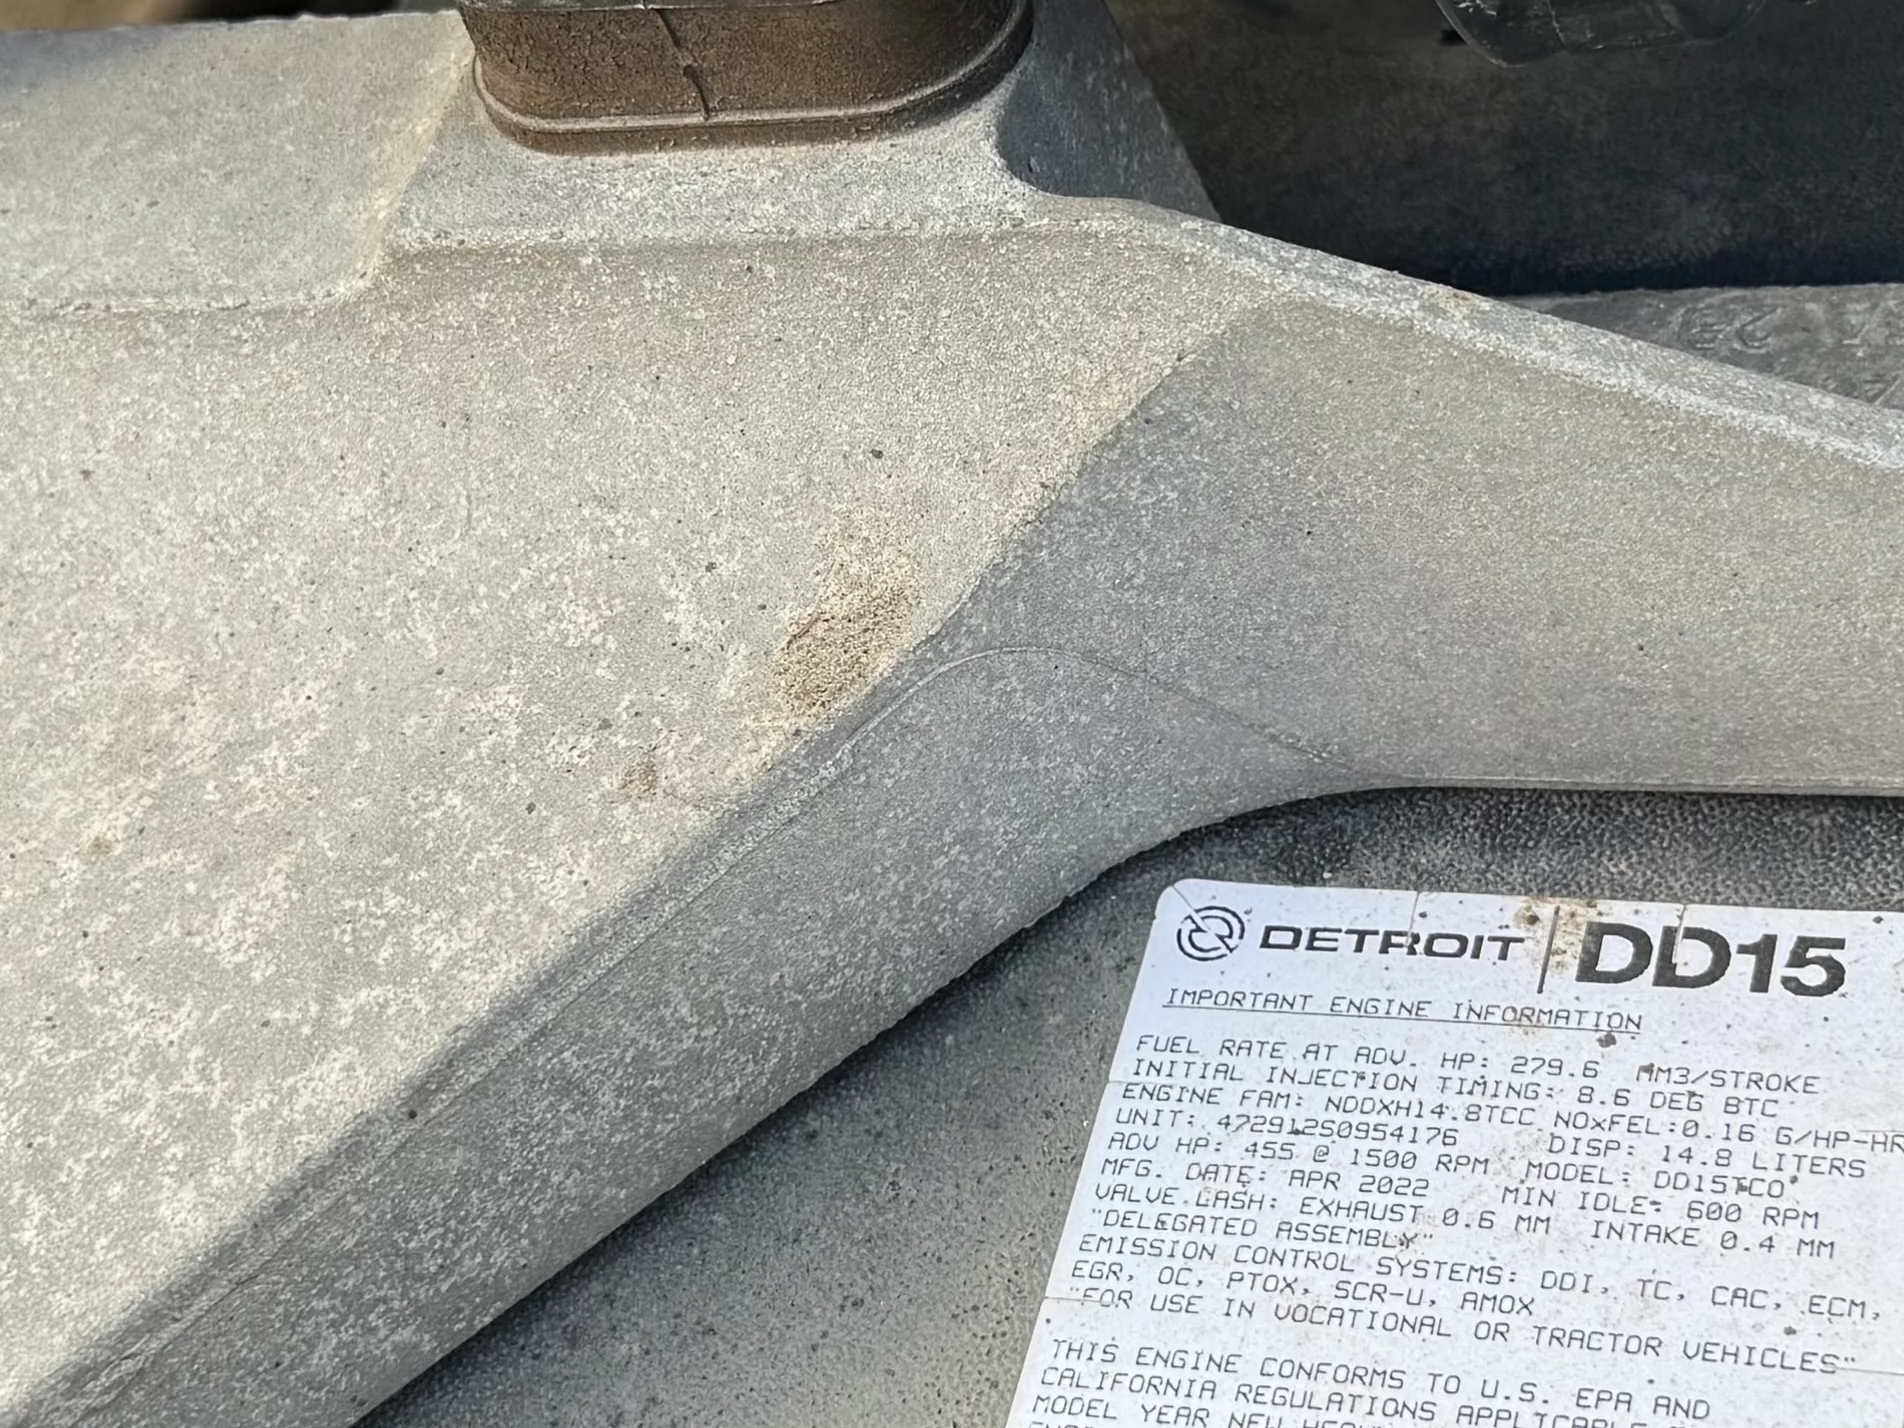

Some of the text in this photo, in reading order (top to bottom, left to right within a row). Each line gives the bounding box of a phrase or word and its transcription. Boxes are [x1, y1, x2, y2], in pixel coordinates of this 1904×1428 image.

[1259, 921, 1846, 998] DETROIT DD15
[1167, 987, 1643, 1030] IMPORTANT ENGINE INFORMATION
[1135, 1034, 1200, 1054] FUEL
[1218, 1038, 1288, 1060] RATE
[1301, 1043, 1339, 1062] AT
[1353, 1045, 1417, 1067] ADV.
[1439, 1051, 1489, 1070] HP:
[1510, 1055, 1600, 1079] 279.6
[1121, 1081, 1224, 1106] ENGINE
[1238, 1088, 1303, 1109] FAM:
[1132, 1057, 1779, 1118] INITIAL INJECTION TIMING: 8.6 DEG BTC
[1107, 1131, 1160, 1151] ADV
[1174, 1136, 1223, 1154] HP:
[1243, 1140, 1296, 1161] 455
[1311, 1144, 1330, 1163] @
[1349, 1147, 1418, 1170] 1500
[1434, 1153, 1490, 1175] RPM
[1524, 1160, 1631, 1188] MODEL:
[1115, 1107, 1195, 1128] UNIT:
[1546, 1134, 1635, 1158] DISP:
[1661, 1144, 1733, 1167] 14.8
[1751, 1151, 1867, 1178] LITERS
[1094, 1182, 1835, 1259] VALVE LASH: EXHAUST 0.6 MM INTAKE 0.4 MM
[1100, 1157, 1819, 1230] MFG. DATE: APR 2022 MIN IDLE: 600 RPM
[1070, 1259, 1535, 1316] EGR, OC, PTOX, SCR-U, AMOX
[1078, 1233, 1880, 1320] EMISSION CONTROL SYSTEMS: DDI, TC, CAC, ECM,
[1149, 1293, 1204, 1314] USE
[1222, 1297, 1256, 1319] IN
[1273, 1302, 1452, 1338] VOCATIONAL
[1473, 1320, 1510, 1343] OR
[1532, 1324, 1662, 1357] TRACTOR
[1040, 1366, 1217, 1400] CALIFORNIA
[1234, 1382, 1437, 1422] REGULATIONS
[1052, 1338, 1710, 1421] THIS ENGINE CONFORMS TO U.S. EPA AND
[1031, 1394, 1117, 1420] MODEL
[1140, 1403, 1210, 1428] YEAR
